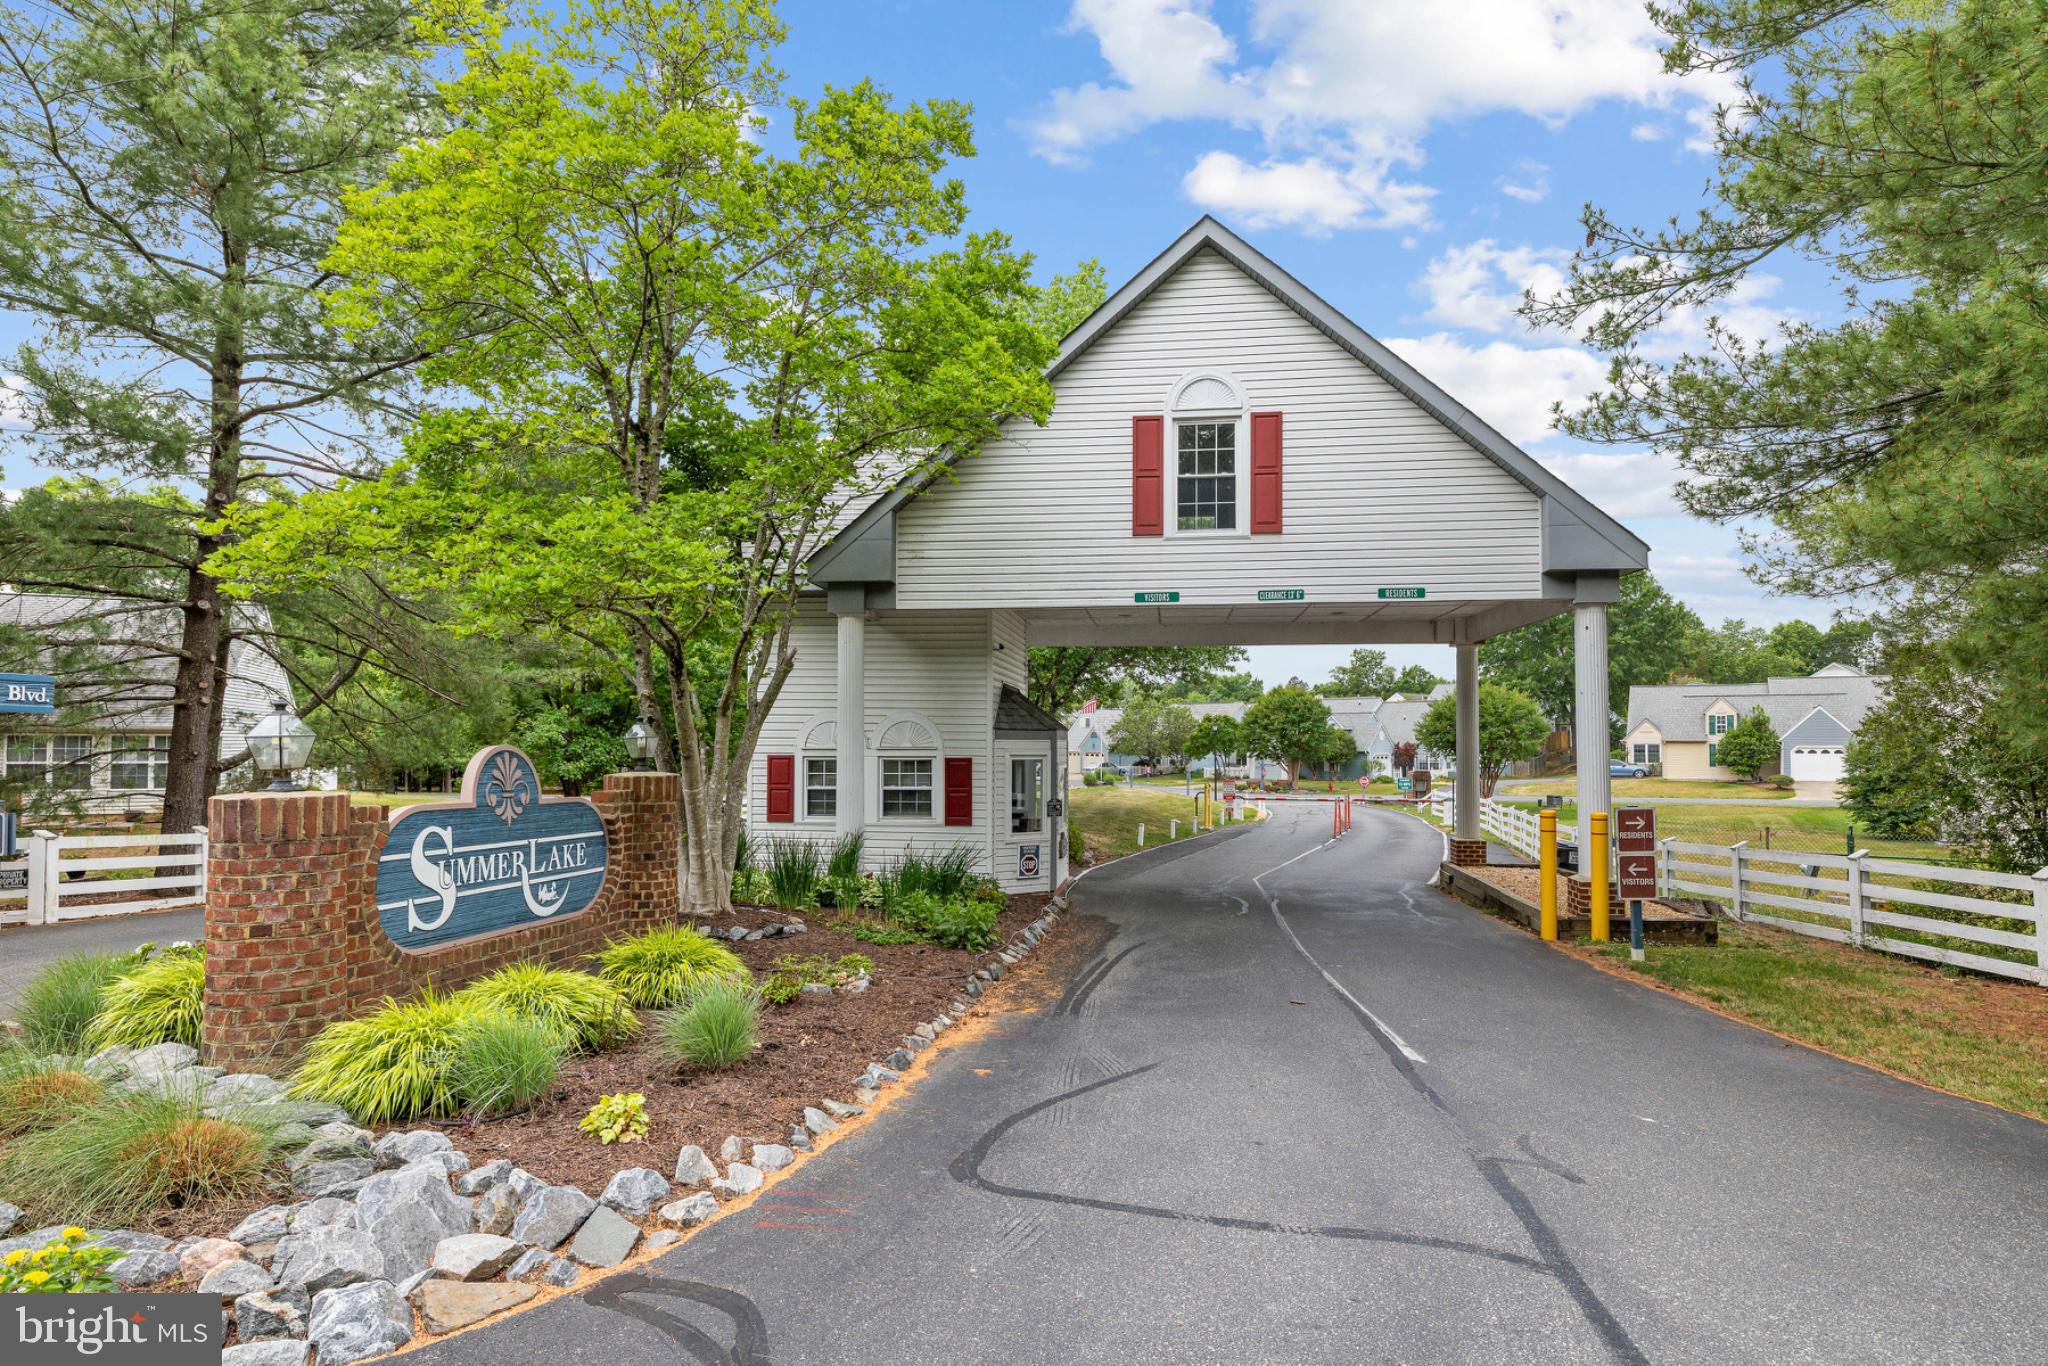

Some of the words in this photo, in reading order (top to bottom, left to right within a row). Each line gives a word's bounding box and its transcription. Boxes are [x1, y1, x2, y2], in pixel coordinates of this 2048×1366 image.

[1143, 592, 1169, 602] VISITORS
[1259, 591, 1288, 600] CLEARANCE
[1385, 589, 1418, 598] RESIDENTS
[7, 684, 49, 703] Blvd.
[1619, 831, 1654, 840] RESIDENTS
[1023, 860, 1036, 870] STOP
[0, 878, 27, 886] ROPERTY
[1622, 877, 1655, 886] VISITORS
